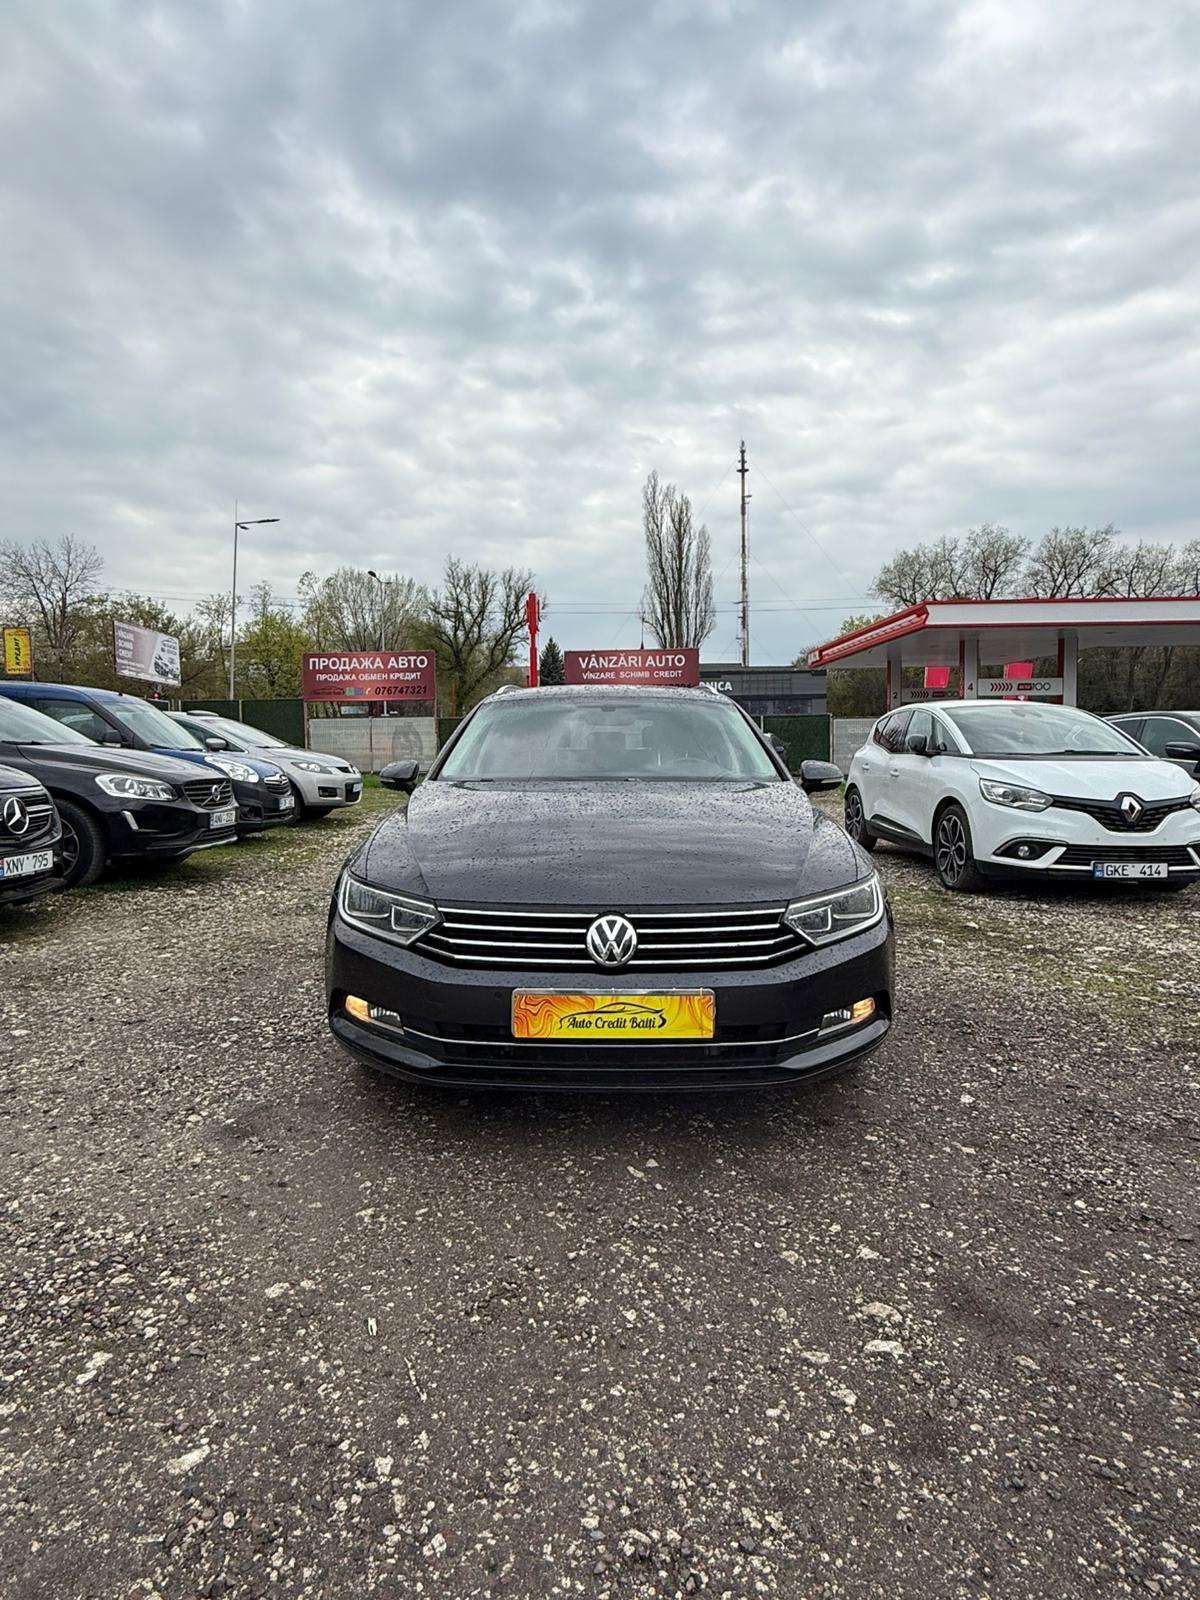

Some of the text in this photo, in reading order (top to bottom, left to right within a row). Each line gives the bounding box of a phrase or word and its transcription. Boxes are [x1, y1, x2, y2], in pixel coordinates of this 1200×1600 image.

[309, 655, 428, 672] ПРОДАЖА АВТО
[578, 653, 686, 669] VÂNZĂRI AUTO
[316, 671, 421, 682] ПРОДАЖА ОБМЕН КРЕДИТ
[582, 670, 682, 680] VÎNZARE SCHIMB CREDIT
[374, 685, 428, 696] 076747321
[967, 683, 974, 692] 4
[6, 853, 49, 875] XNY 795
[1105, 864, 1162, 877] GKE 414
[567, 1017, 592, 1029] Auto
[594, 1017, 627, 1029] Credit
